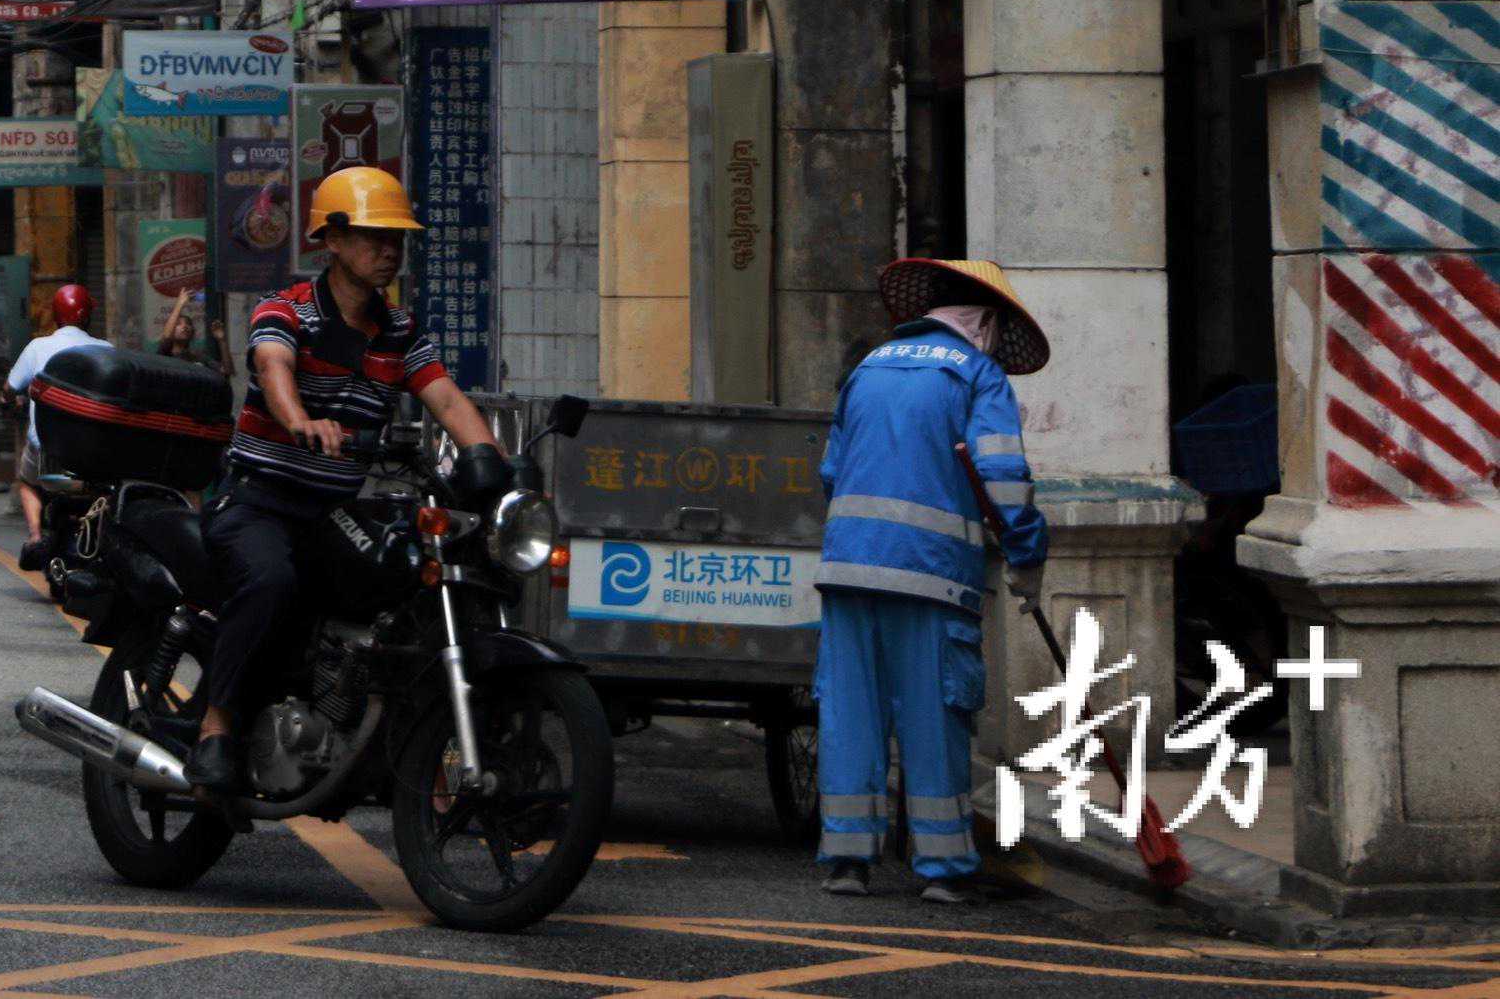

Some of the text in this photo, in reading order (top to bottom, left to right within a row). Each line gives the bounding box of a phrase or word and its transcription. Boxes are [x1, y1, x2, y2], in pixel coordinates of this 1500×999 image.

[727, 453, 814, 494] 环卫
[329, 508, 374, 551] SUZUKI
[663, 551, 792, 587] 北京环卫
[663, 588, 793, 608] BEIJING HUANWEI
